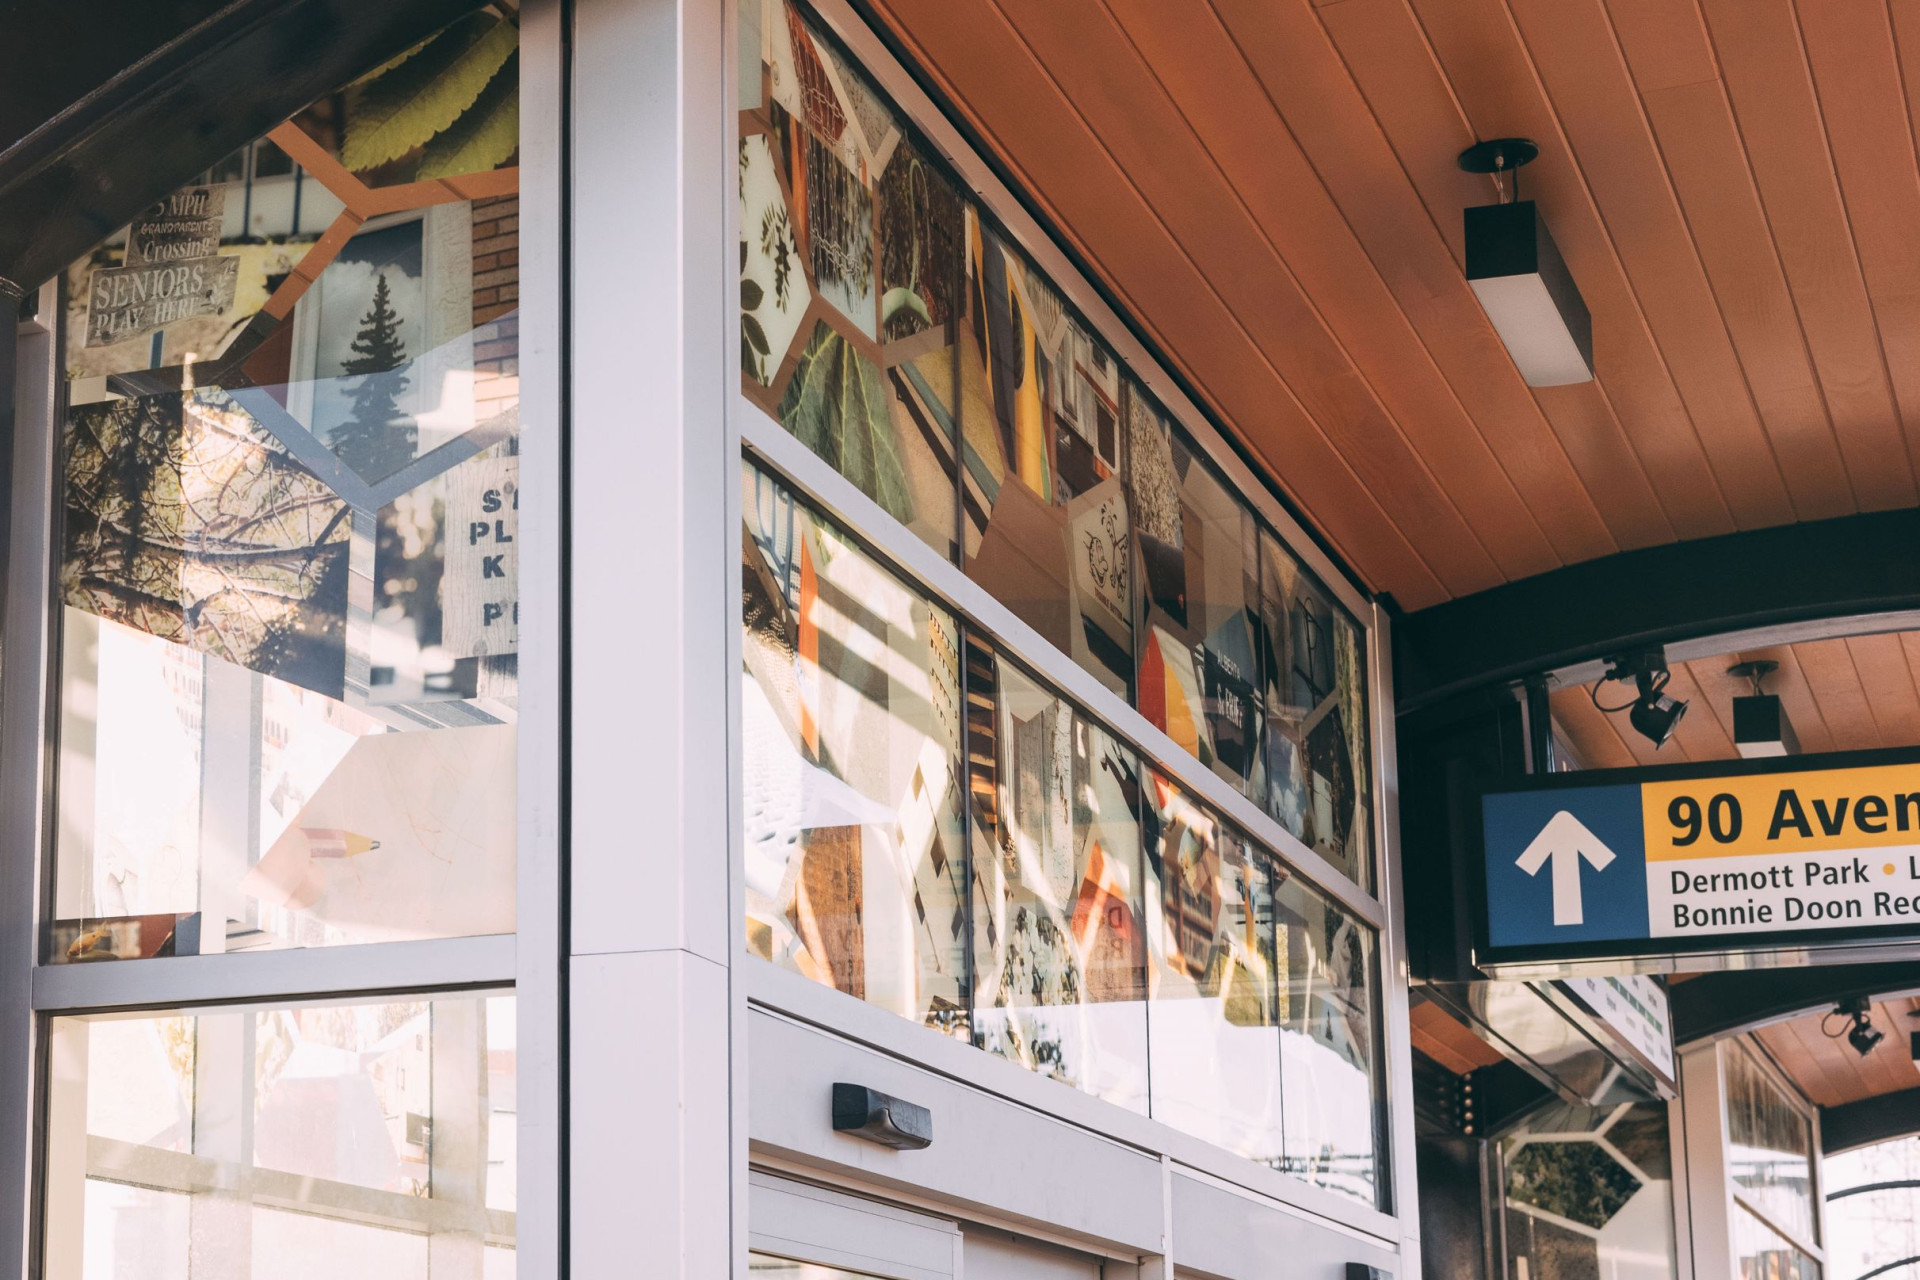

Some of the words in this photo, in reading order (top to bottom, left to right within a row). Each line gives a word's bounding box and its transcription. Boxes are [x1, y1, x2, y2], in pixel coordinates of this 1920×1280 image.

[168, 194, 207, 217] MPH
[143, 237, 211, 262] Crossing
[96, 264, 204, 309] SENIORS
[95, 306, 145, 337] PLAY
[1667, 793, 1743, 847] 90
[1671, 865, 1794, 894] Dermott
[1804, 857, 1870, 887] Park
[1673, 898, 1773, 928] Bonnie
[1784, 897, 1862, 922] Doon
